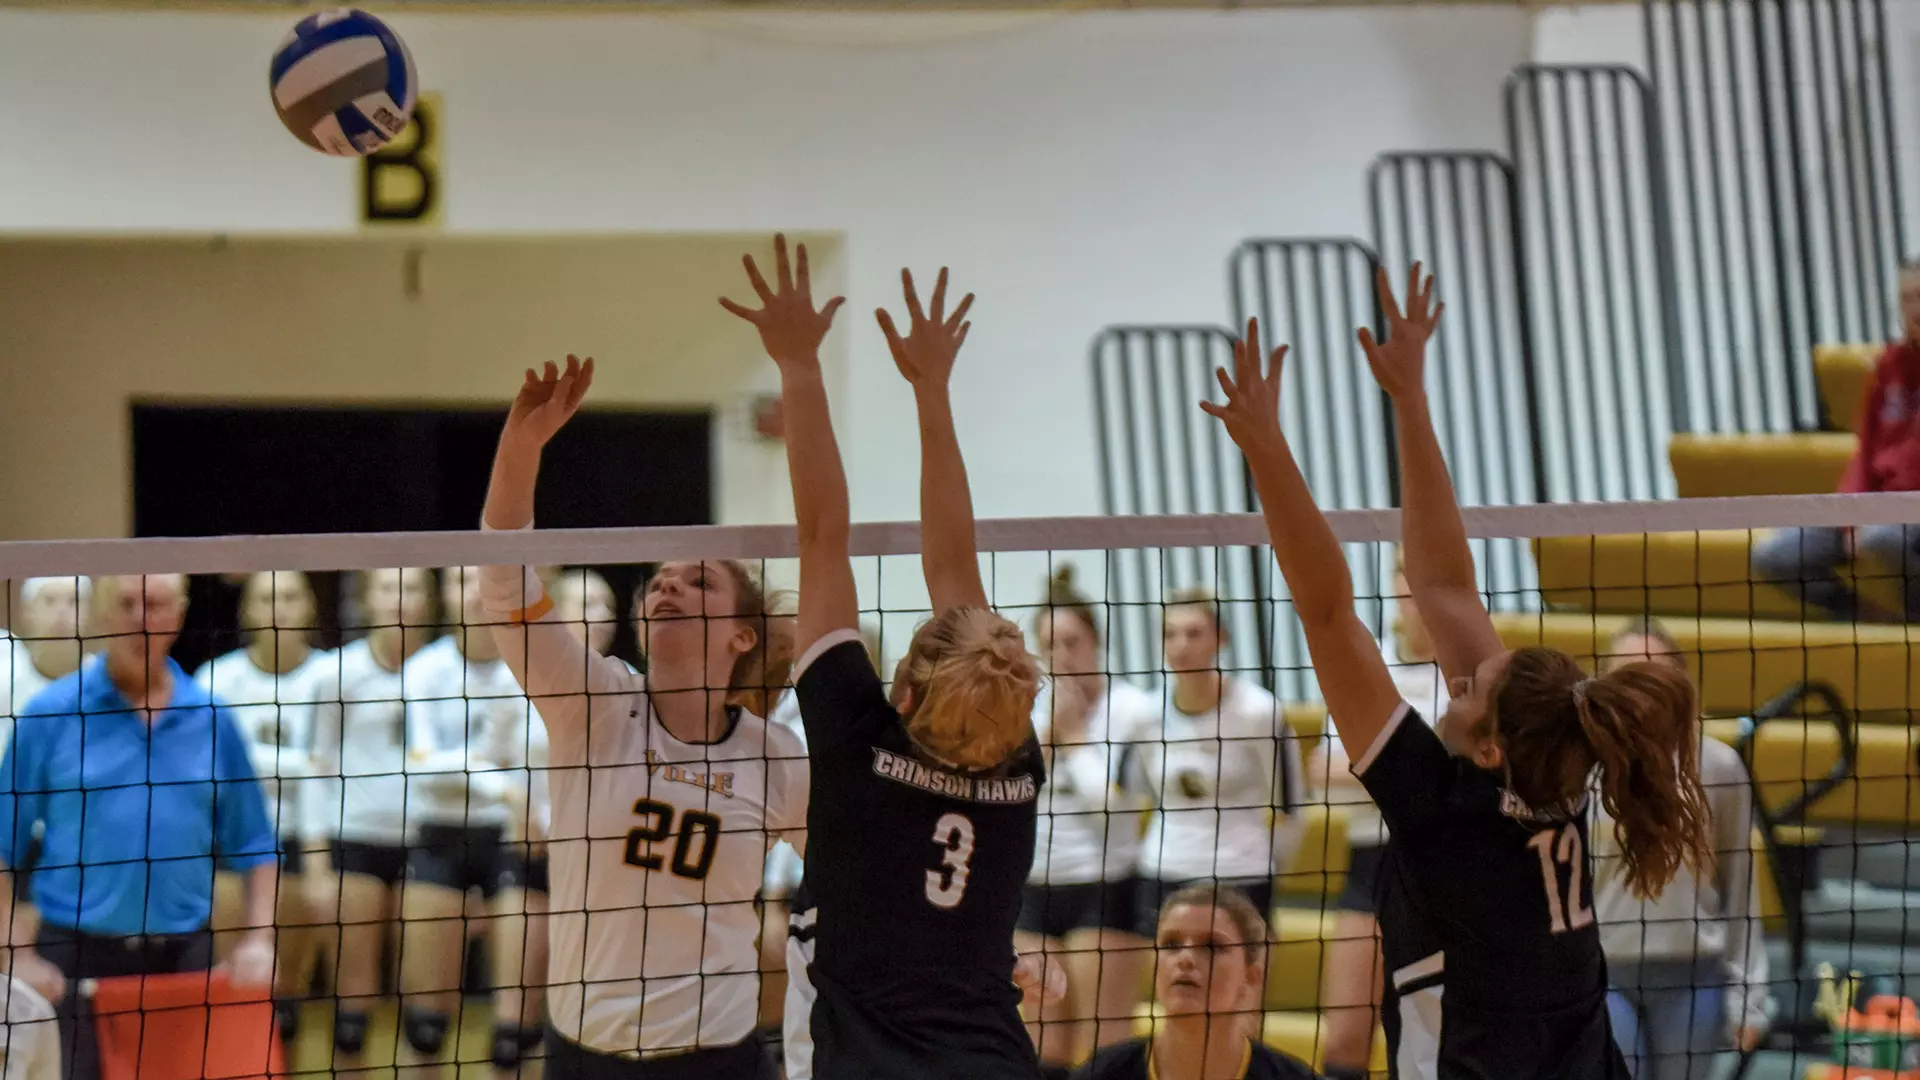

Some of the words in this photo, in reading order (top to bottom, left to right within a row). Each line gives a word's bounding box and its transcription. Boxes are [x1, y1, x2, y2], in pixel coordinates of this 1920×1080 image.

[365, 101, 433, 221] B
[873, 749, 973, 800] CRIMSON
[976, 775, 1036, 802] HAWKS
[623, 797, 722, 881] 20
[924, 812, 976, 909] 3
[1526, 820, 1595, 935] 12
